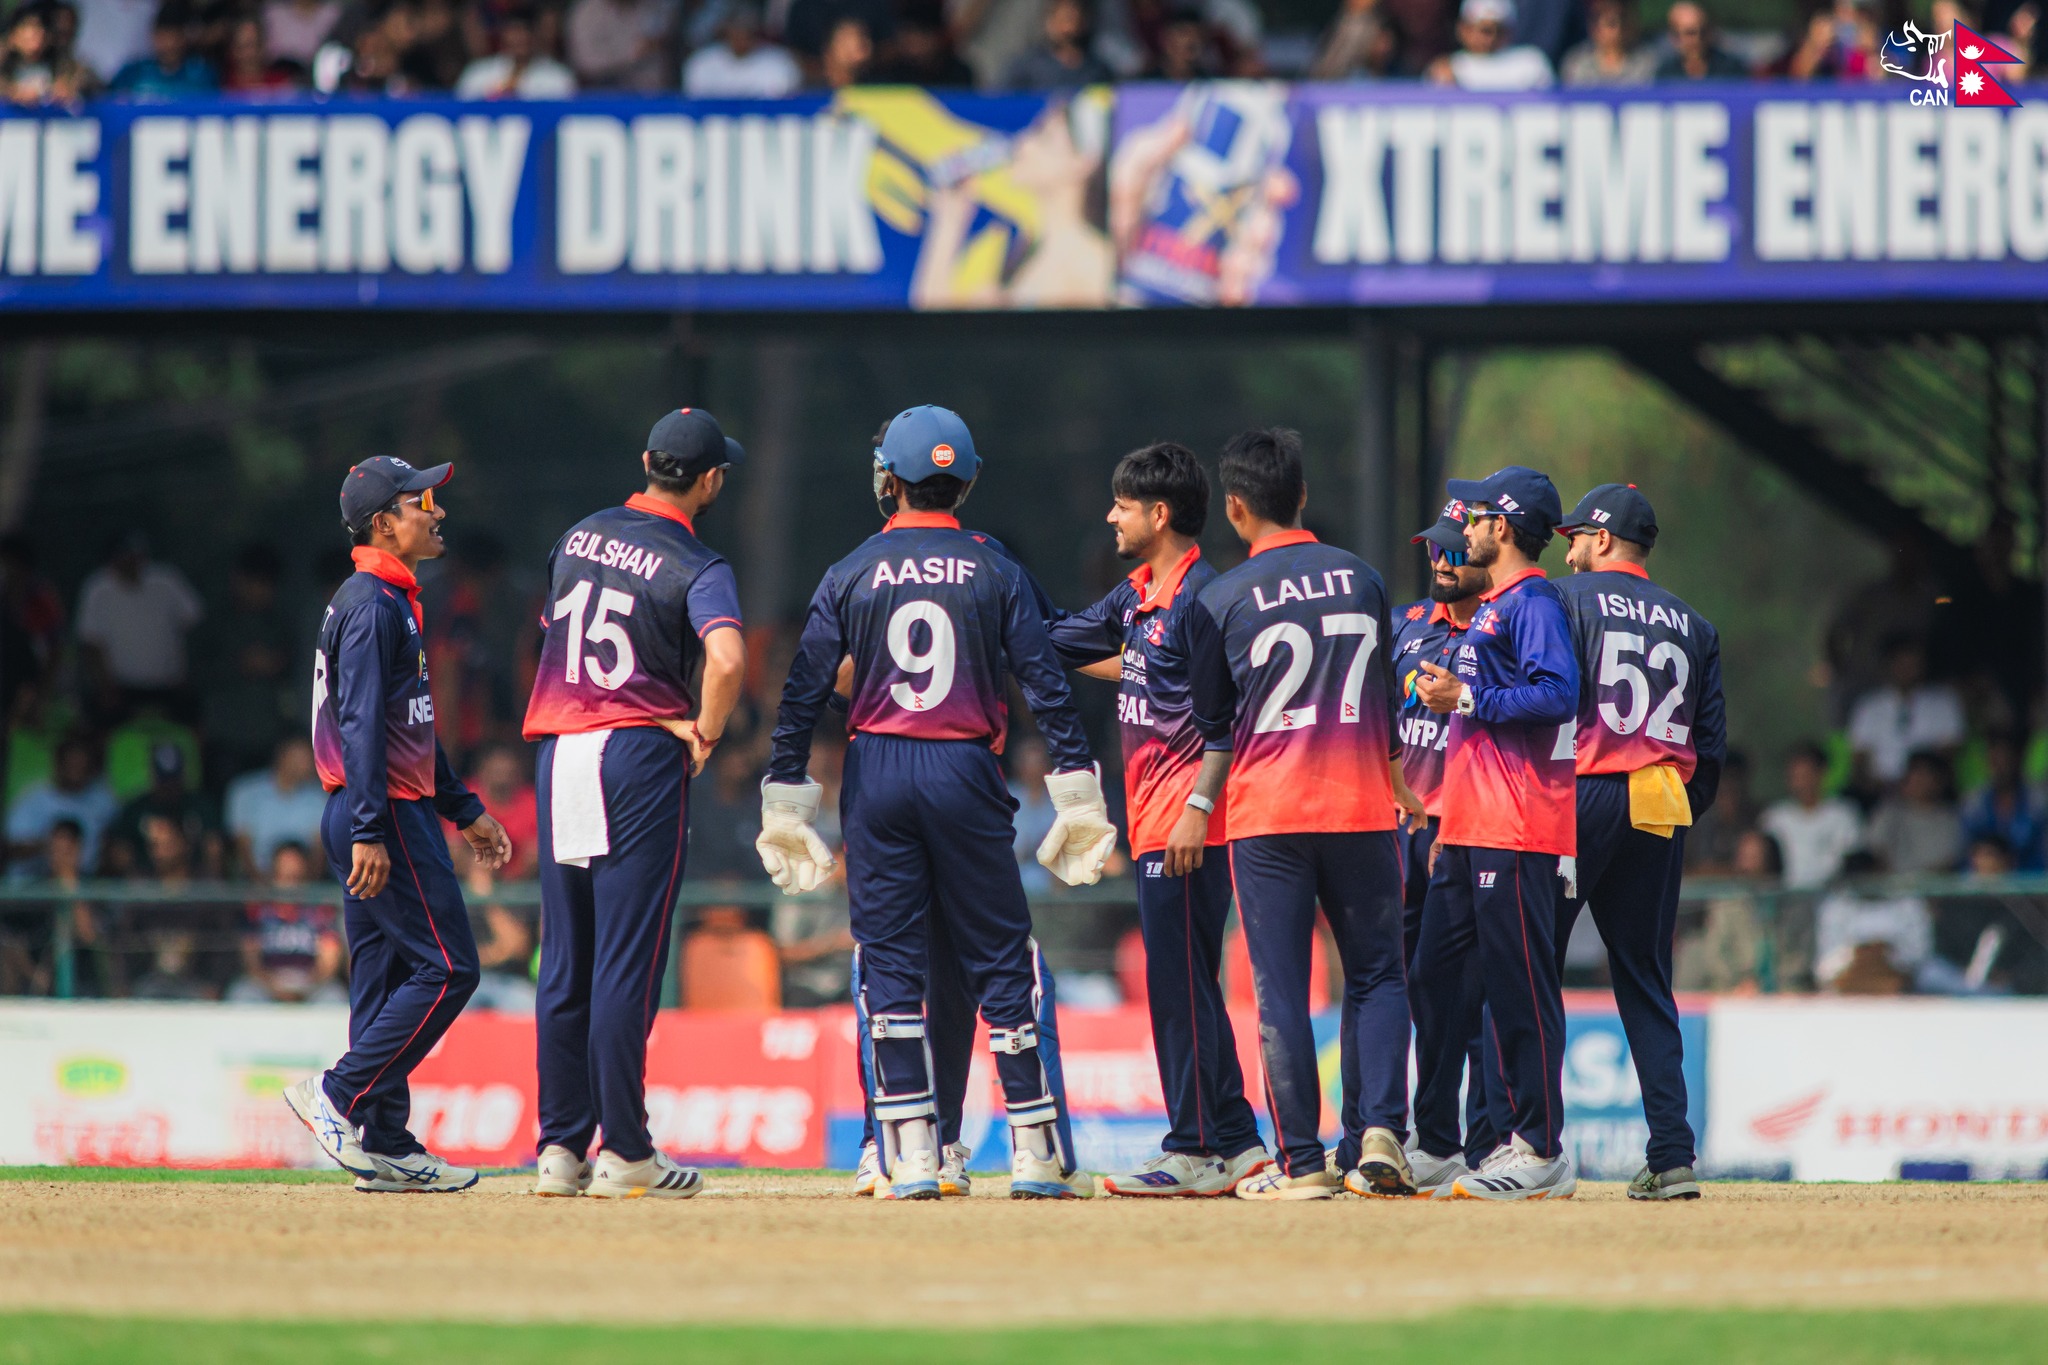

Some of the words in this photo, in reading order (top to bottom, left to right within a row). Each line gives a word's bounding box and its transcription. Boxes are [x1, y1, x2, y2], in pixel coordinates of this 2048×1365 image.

[130, 113, 531, 274] ENERGY
[557, 112, 884, 274] DRINK
[1313, 102, 1731, 264] XTREME
[1754, 100, 2048, 262] ENERG
[565, 530, 663, 581] GULSHAN
[872, 558, 976, 589] AASIF
[1252, 569, 1354, 612] LALIT
[552, 580, 635, 691] 15
[1598, 593, 1689, 637] ISHAN
[887, 600, 955, 712] 9
[1250, 613, 1378, 734] 27
[1598, 631, 1690, 745] 52
[408, 694, 435, 725] NE
[1118, 693, 1154, 726] PAL
